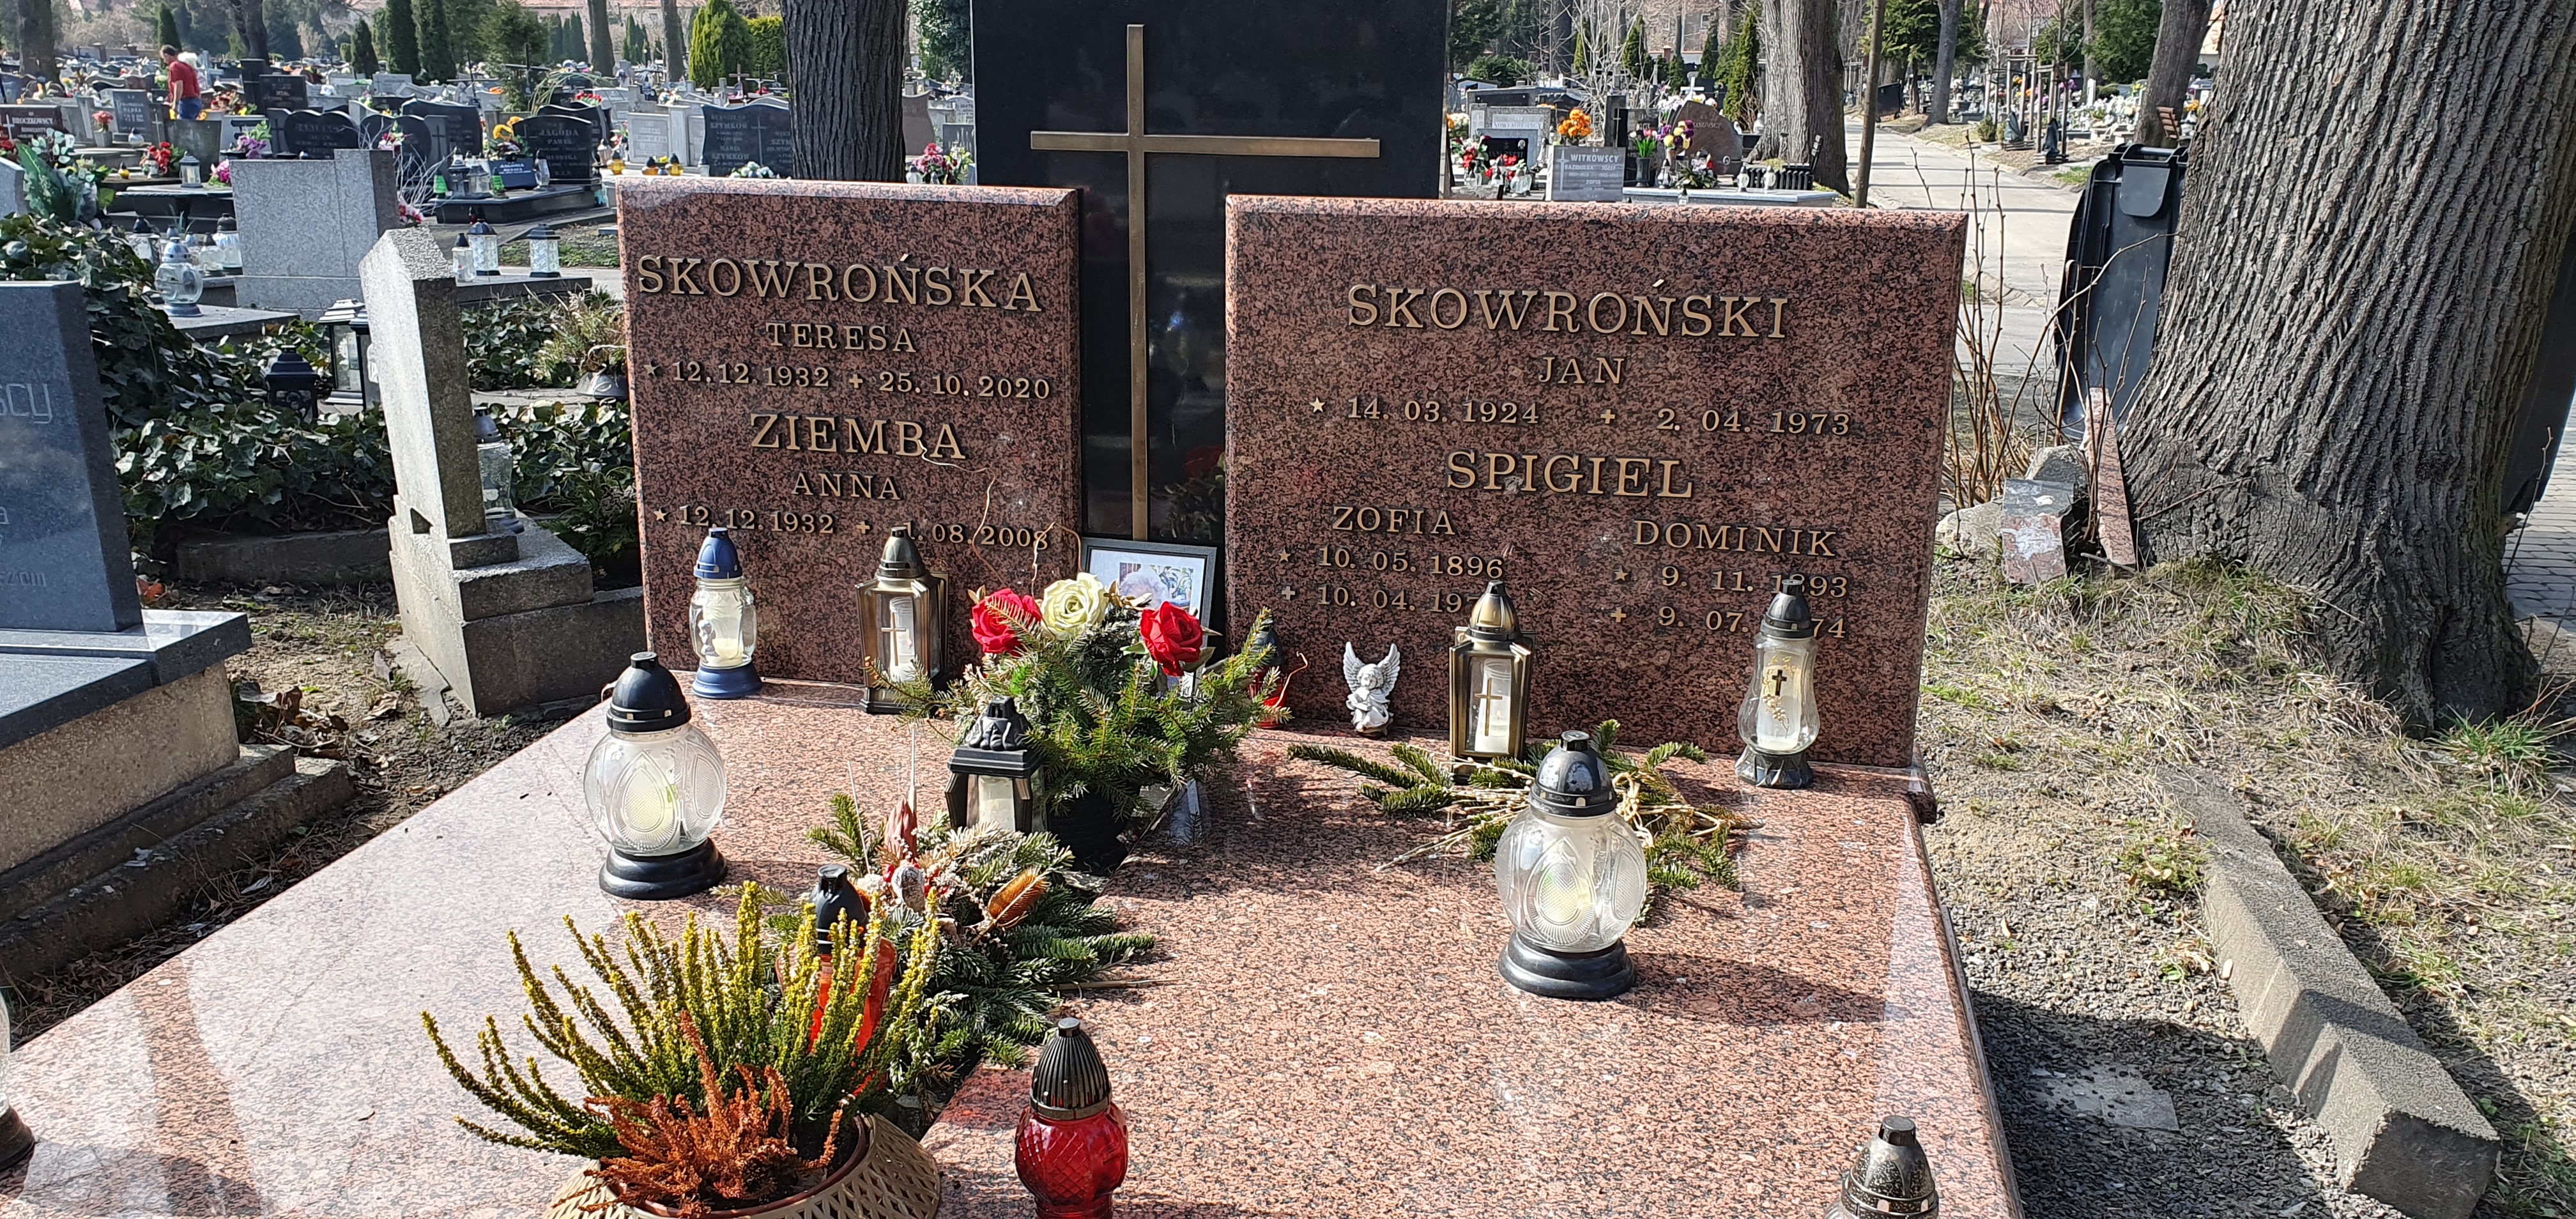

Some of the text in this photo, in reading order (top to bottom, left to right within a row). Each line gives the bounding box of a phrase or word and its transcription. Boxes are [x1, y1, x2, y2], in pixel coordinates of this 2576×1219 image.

[1570, 154, 1619, 163] WITKOWSCY
[639, 254, 1042, 312] SKOWROŃSKA
[1347, 279, 1788, 339] SKOWROŃSKI
[767, 321, 917, 353] TERESA
[1538, 356, 1625, 384] JAN
[749, 413, 966, 459] ZIEMBA
[790, 471, 901, 501] ANNA
[1446, 451, 1693, 498] SPIGIEL
[1331, 506, 1456, 535] ZOFIA
[1633, 519, 1837, 556] DOMINIK
